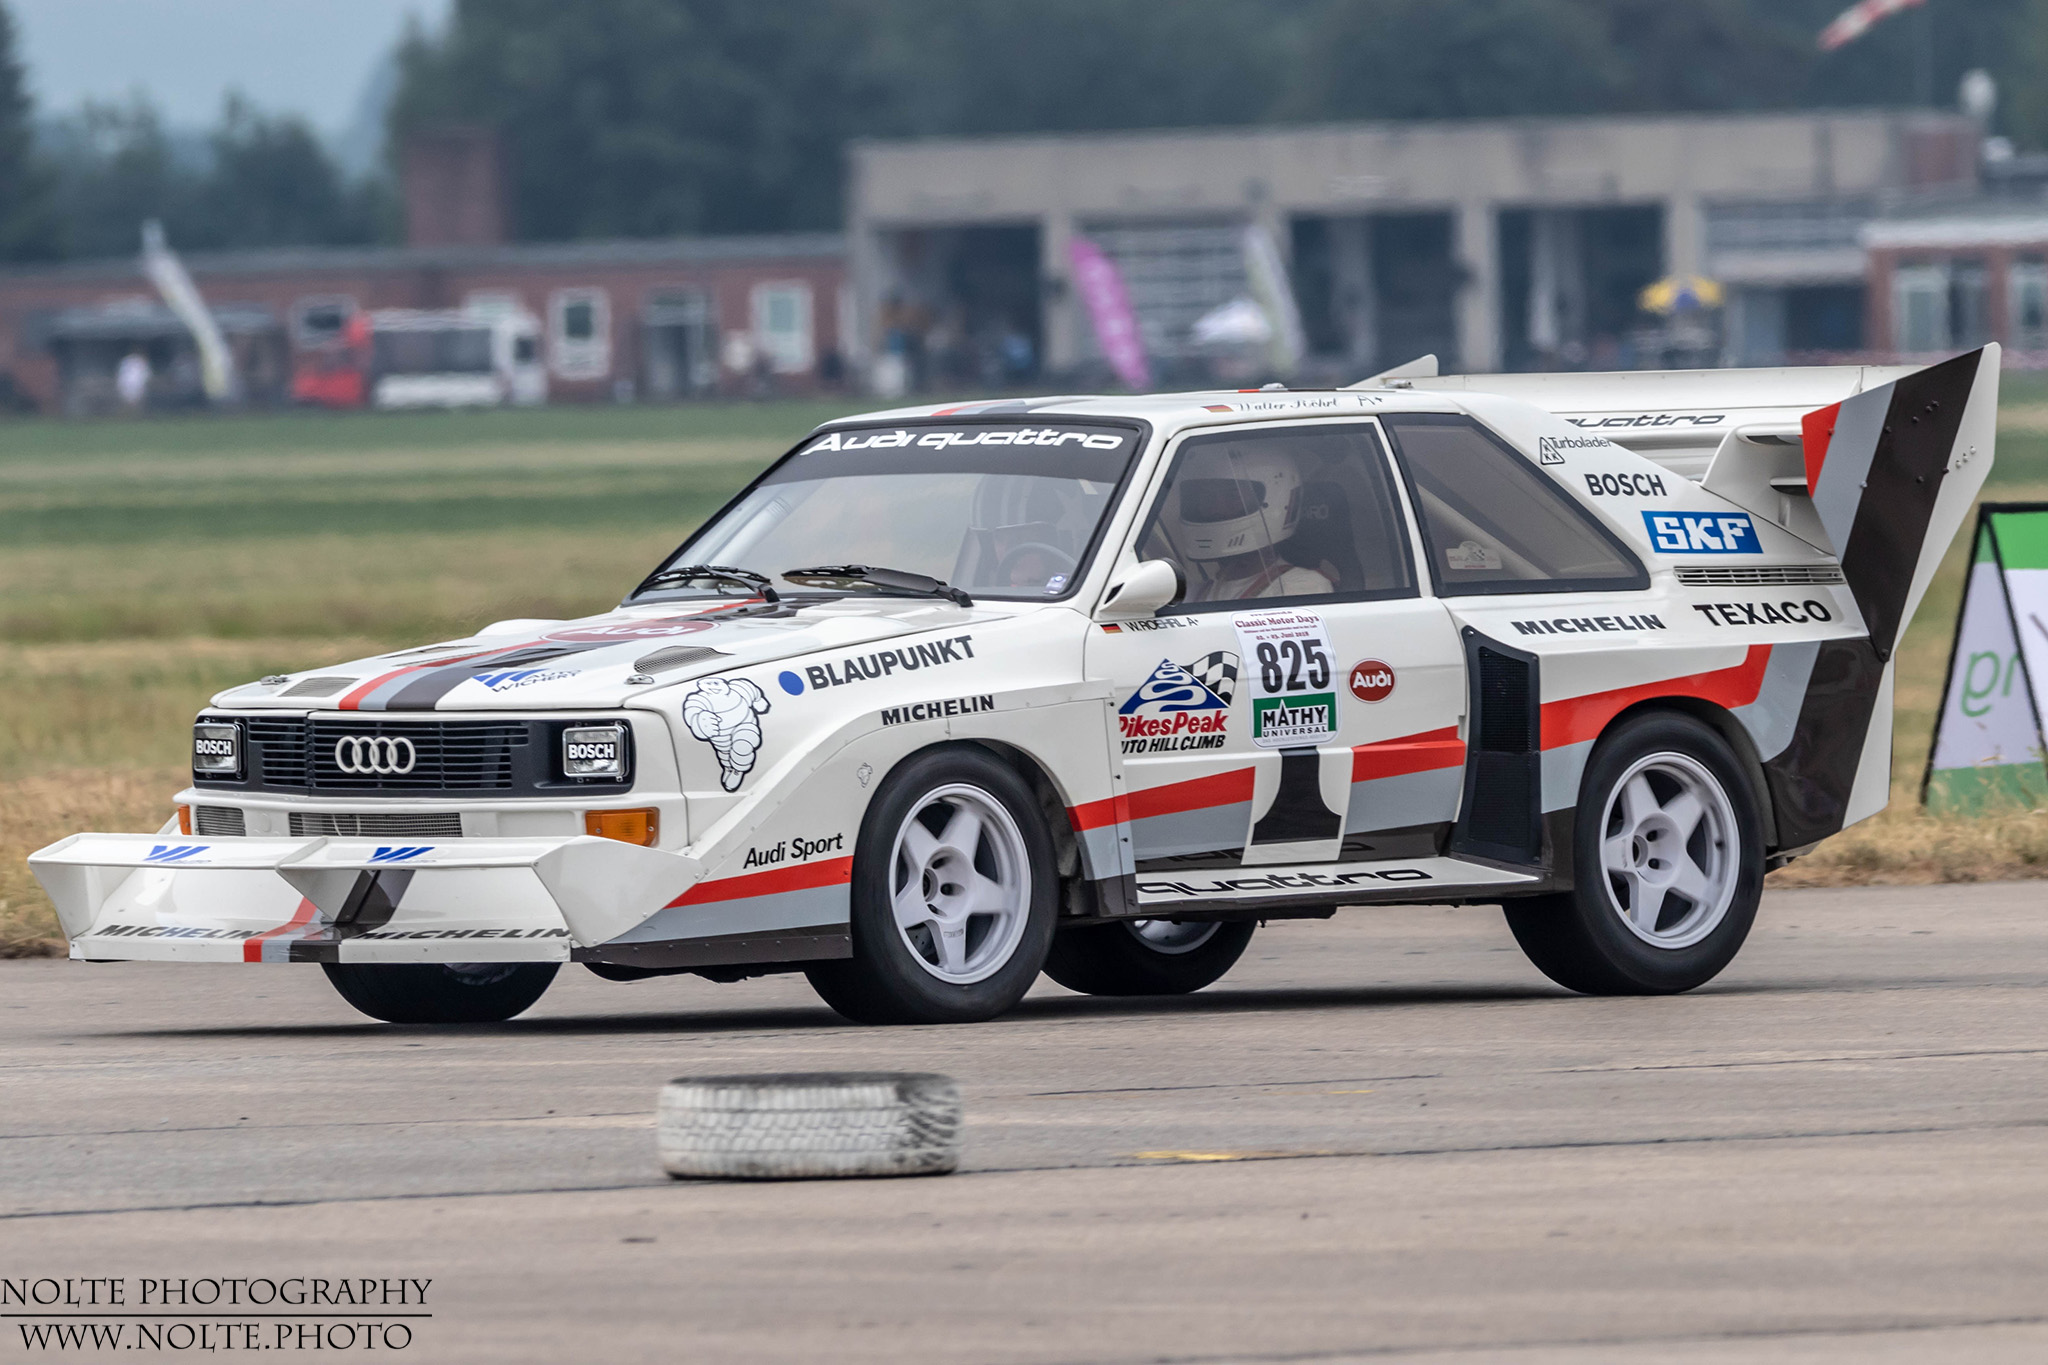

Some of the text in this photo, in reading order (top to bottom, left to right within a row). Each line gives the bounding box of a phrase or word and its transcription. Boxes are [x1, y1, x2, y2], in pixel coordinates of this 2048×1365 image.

[800, 428, 1124, 456] Audi quattro
[1548, 436, 1612, 449] Turbolader
[1584, 473, 1667, 498] BOSCH
[1652, 516, 1750, 551] SKF
[1235, 615, 1320, 628] Classic Motor Days
[1693, 599, 1832, 627] TEXACO
[1511, 614, 1667, 635] MICHELIN
[806, 635, 977, 691] BLAUPUNKT
[1256, 639, 1330, 693] 825
[492, 673, 579, 693] WICHERT
[1352, 671, 1393, 690] Audi
[880, 694, 995, 727] MICHELIN
[1263, 705, 1326, 727] MATHY
[1263, 726, 1327, 737] UNIVERSAL
[195, 739, 232, 755] BOSCH
[568, 743, 615, 759] BOSCH
[743, 832, 844, 869] Audi Sport
[1137, 869, 1433, 896] quattro
[94, 924, 265, 939] MICHELIN
[353, 929, 572, 940] MICHELIN
